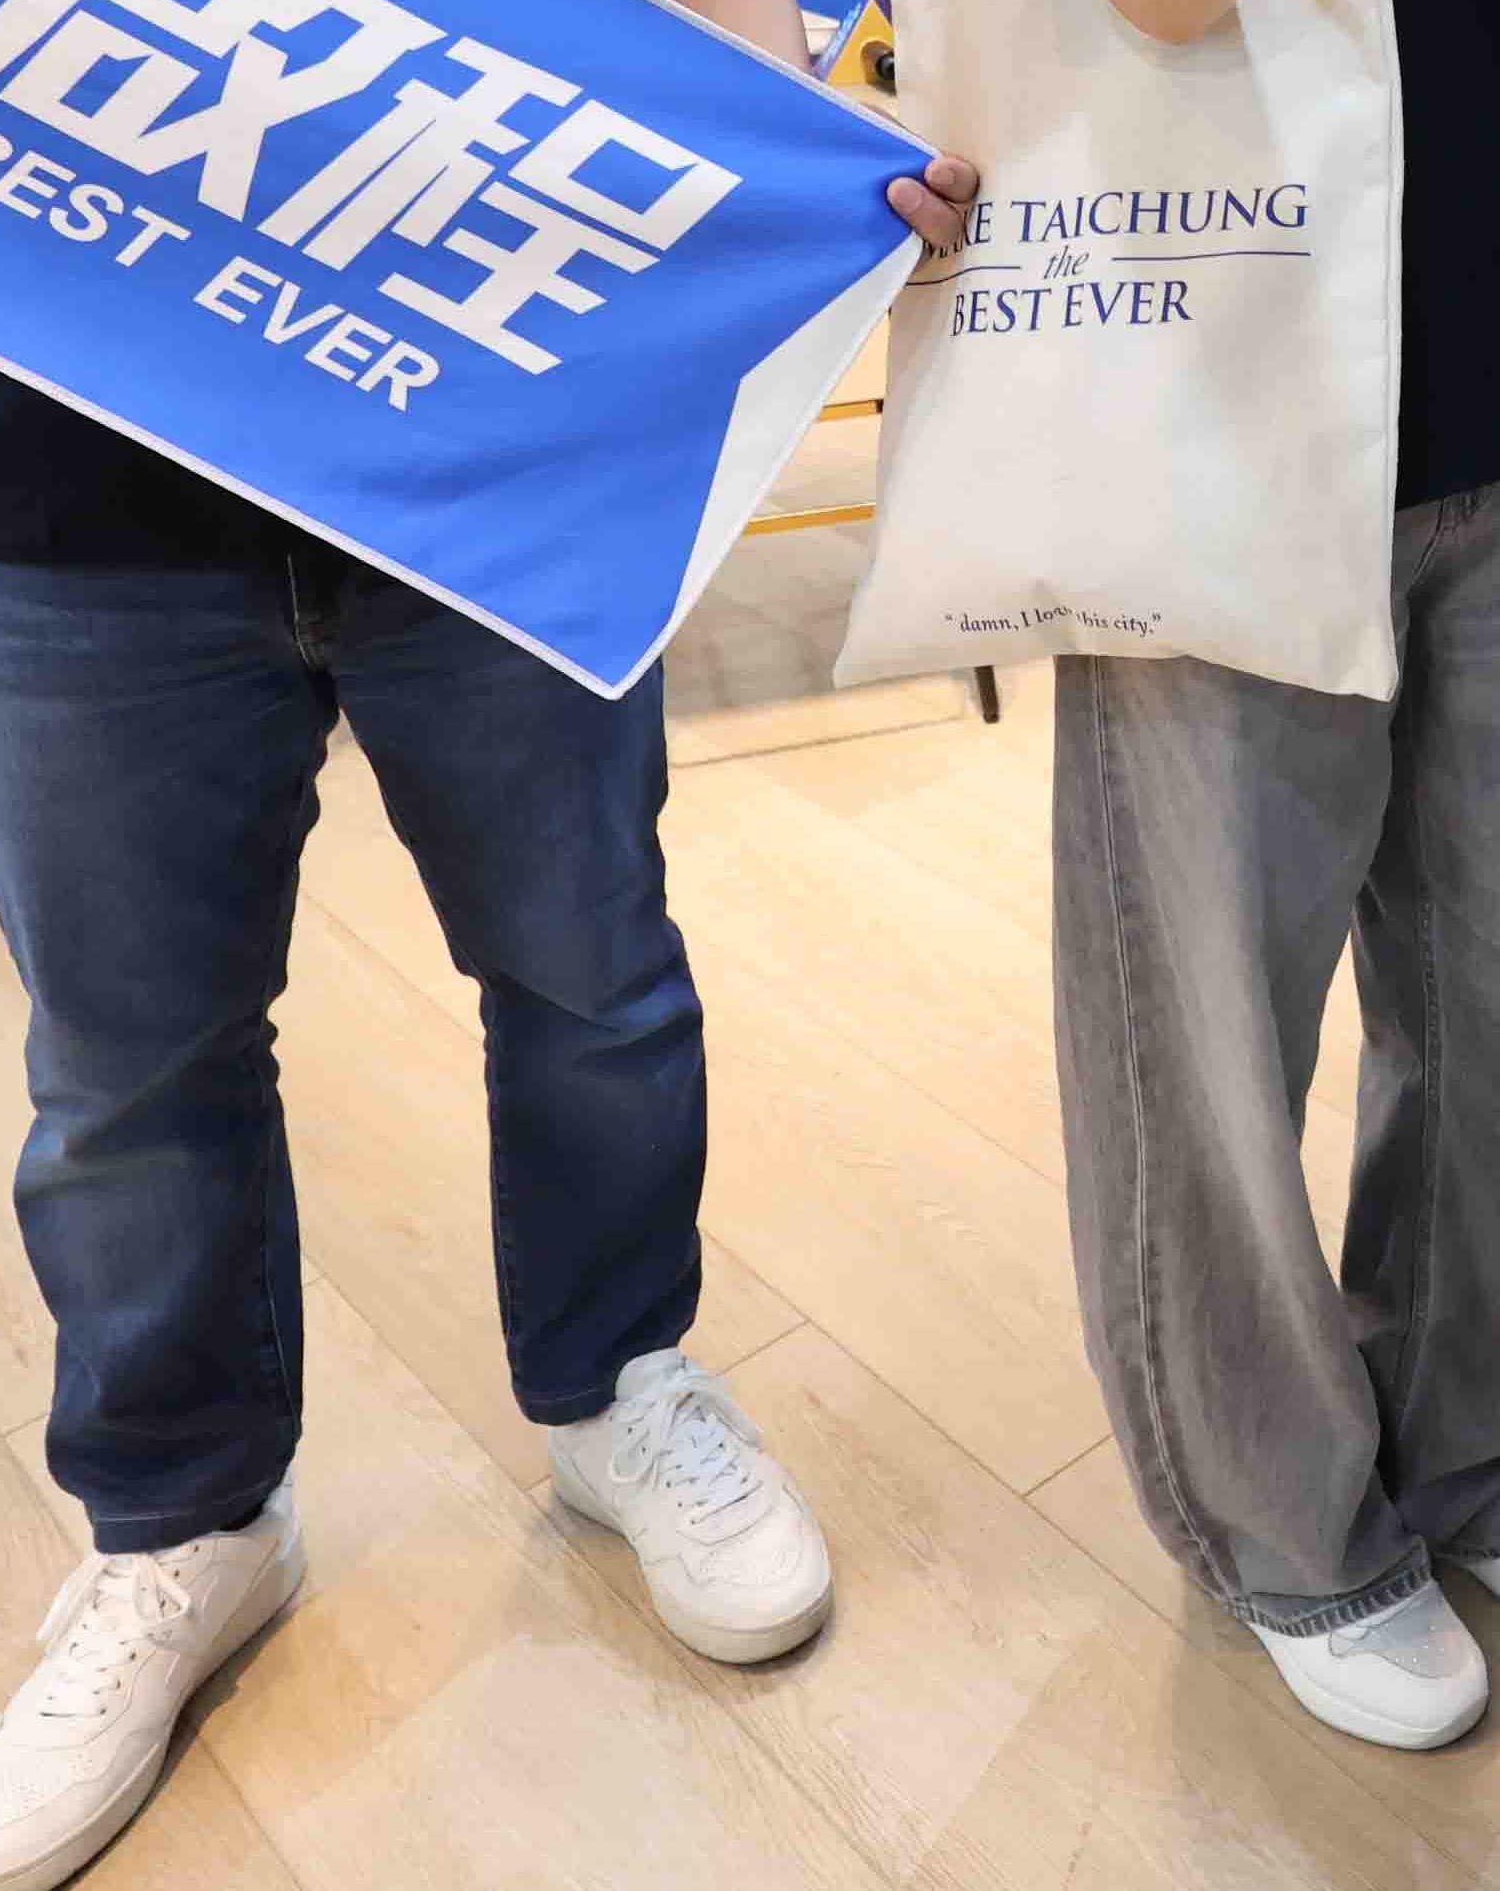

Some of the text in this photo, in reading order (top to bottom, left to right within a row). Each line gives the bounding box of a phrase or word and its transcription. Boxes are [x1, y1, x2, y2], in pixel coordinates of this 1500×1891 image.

[1011, 184, 1308, 244] TAICHUNG
[1043, 244, 1090, 280] the
[194, 258, 440, 412] EVER
[952, 279, 1197, 337] BEST EVER
